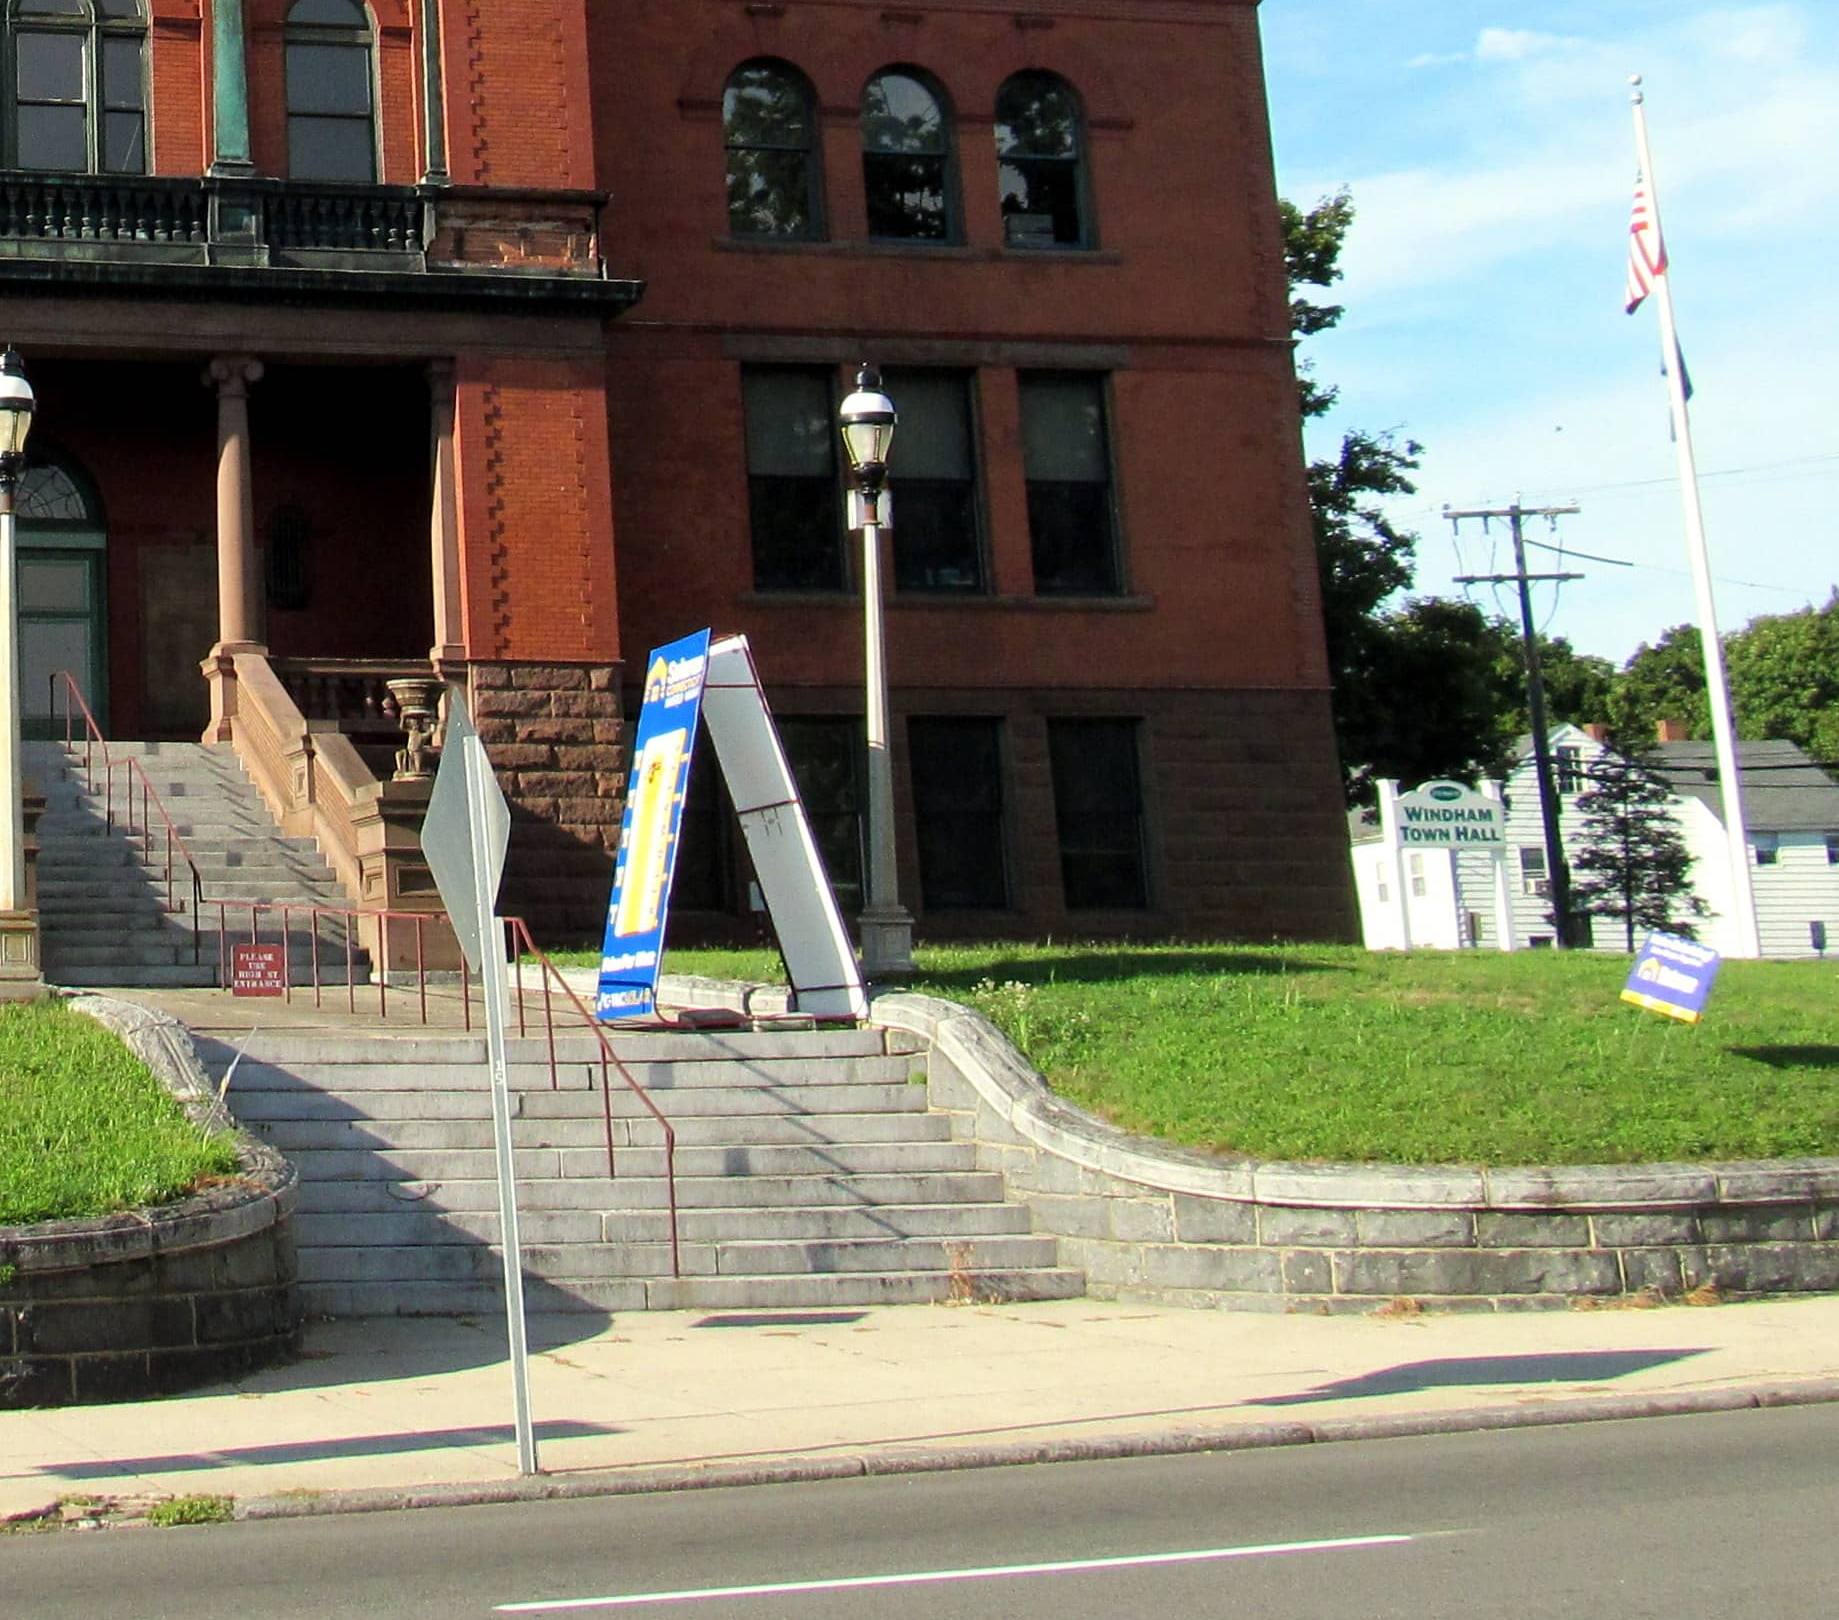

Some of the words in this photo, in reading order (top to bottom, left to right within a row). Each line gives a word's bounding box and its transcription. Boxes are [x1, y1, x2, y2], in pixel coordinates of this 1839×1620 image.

[240, 953, 274, 961] PLEASE
[248, 962, 266, 970] USE
[238, 971, 262, 979] HIGH
[234, 980, 281, 988] ENTRANCE
